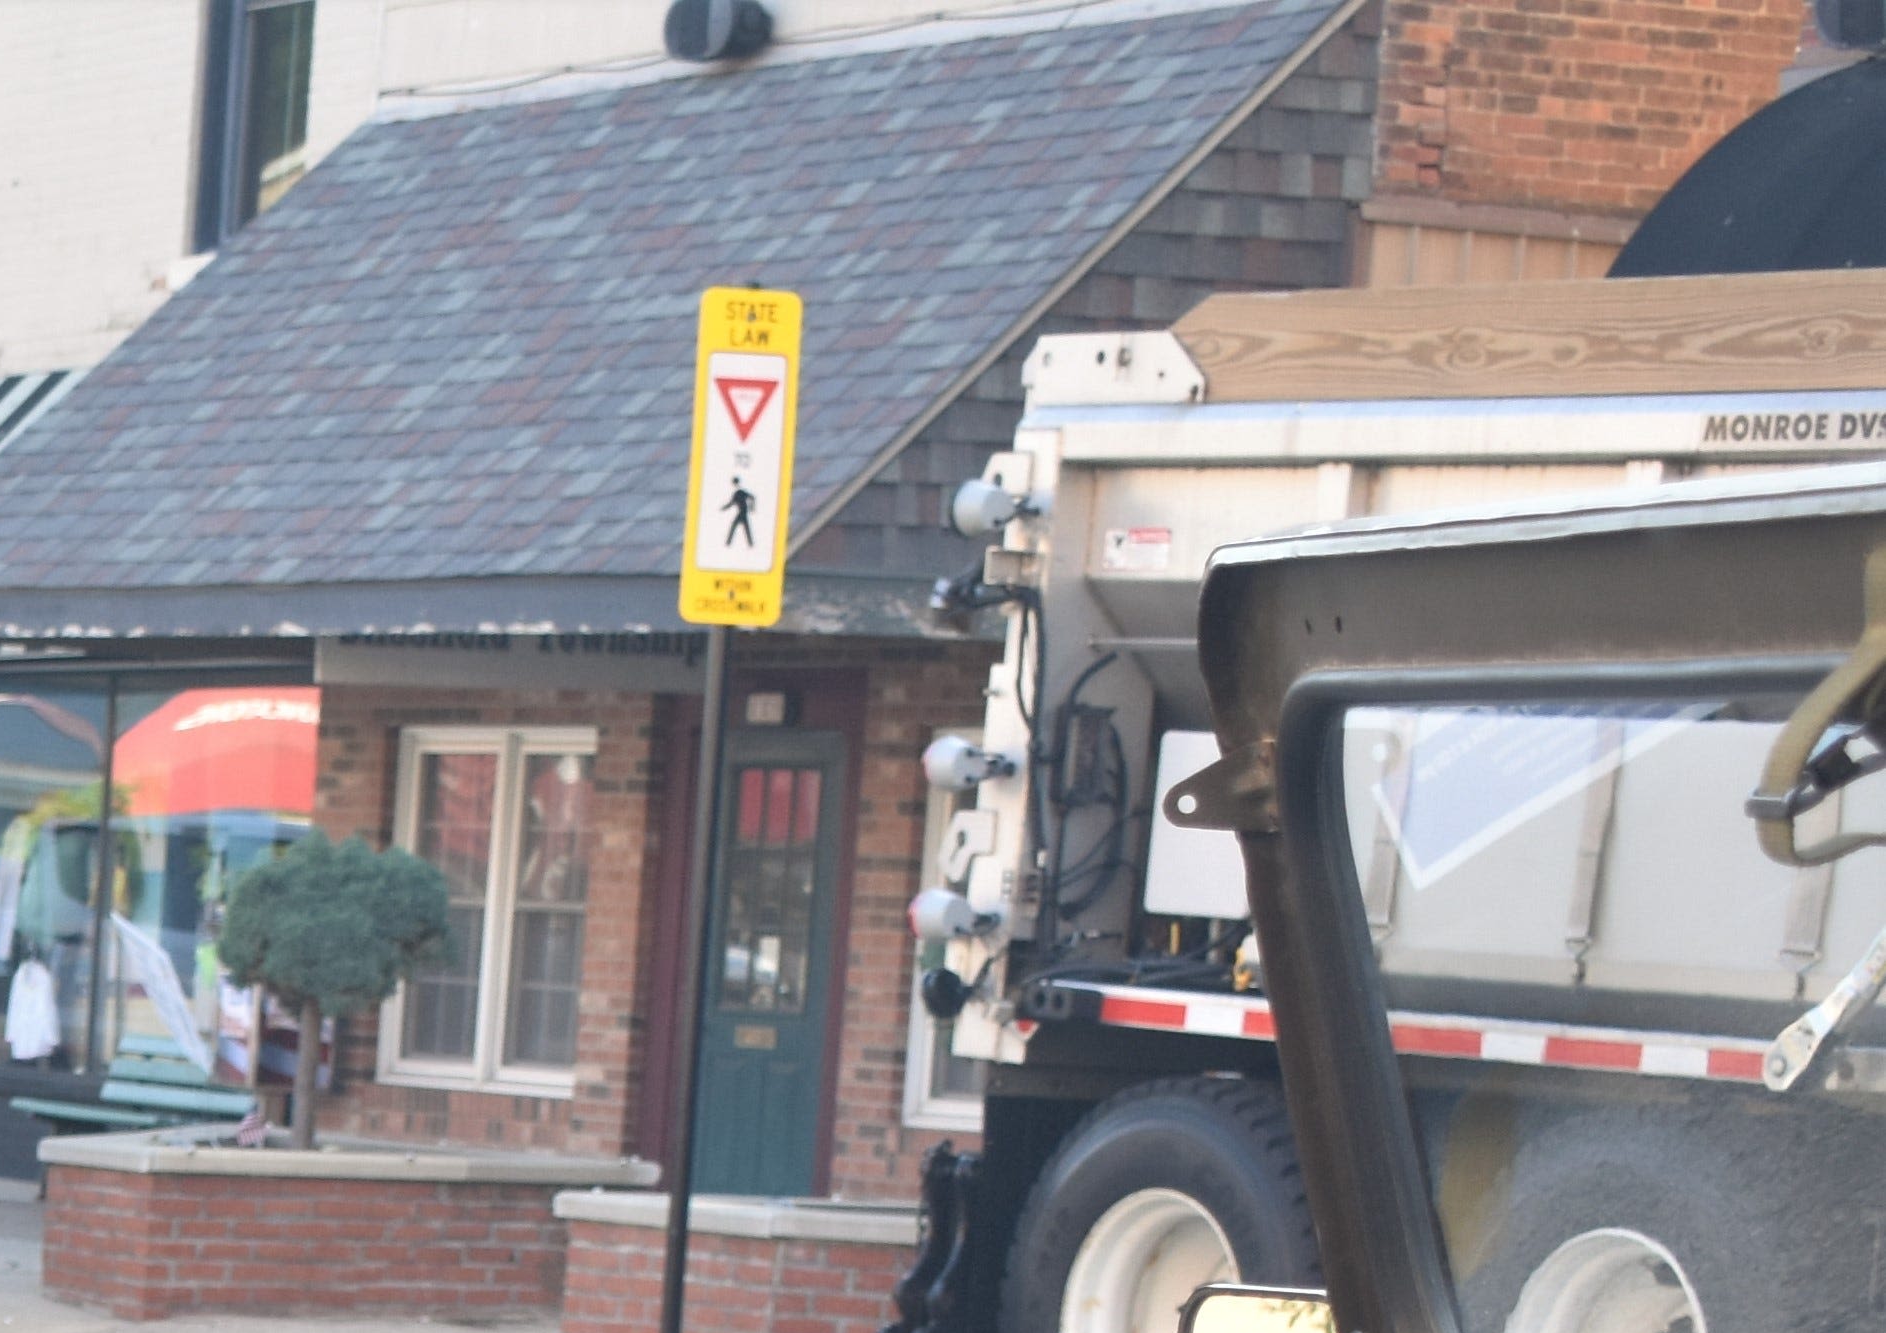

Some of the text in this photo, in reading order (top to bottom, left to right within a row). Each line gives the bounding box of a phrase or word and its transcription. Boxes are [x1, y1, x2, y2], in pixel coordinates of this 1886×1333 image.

[725, 302, 778, 324] STATE
[730, 329, 770, 346] LAW
[1703, 414, 1829, 442] MONROE
[734, 453, 751, 468] TO
